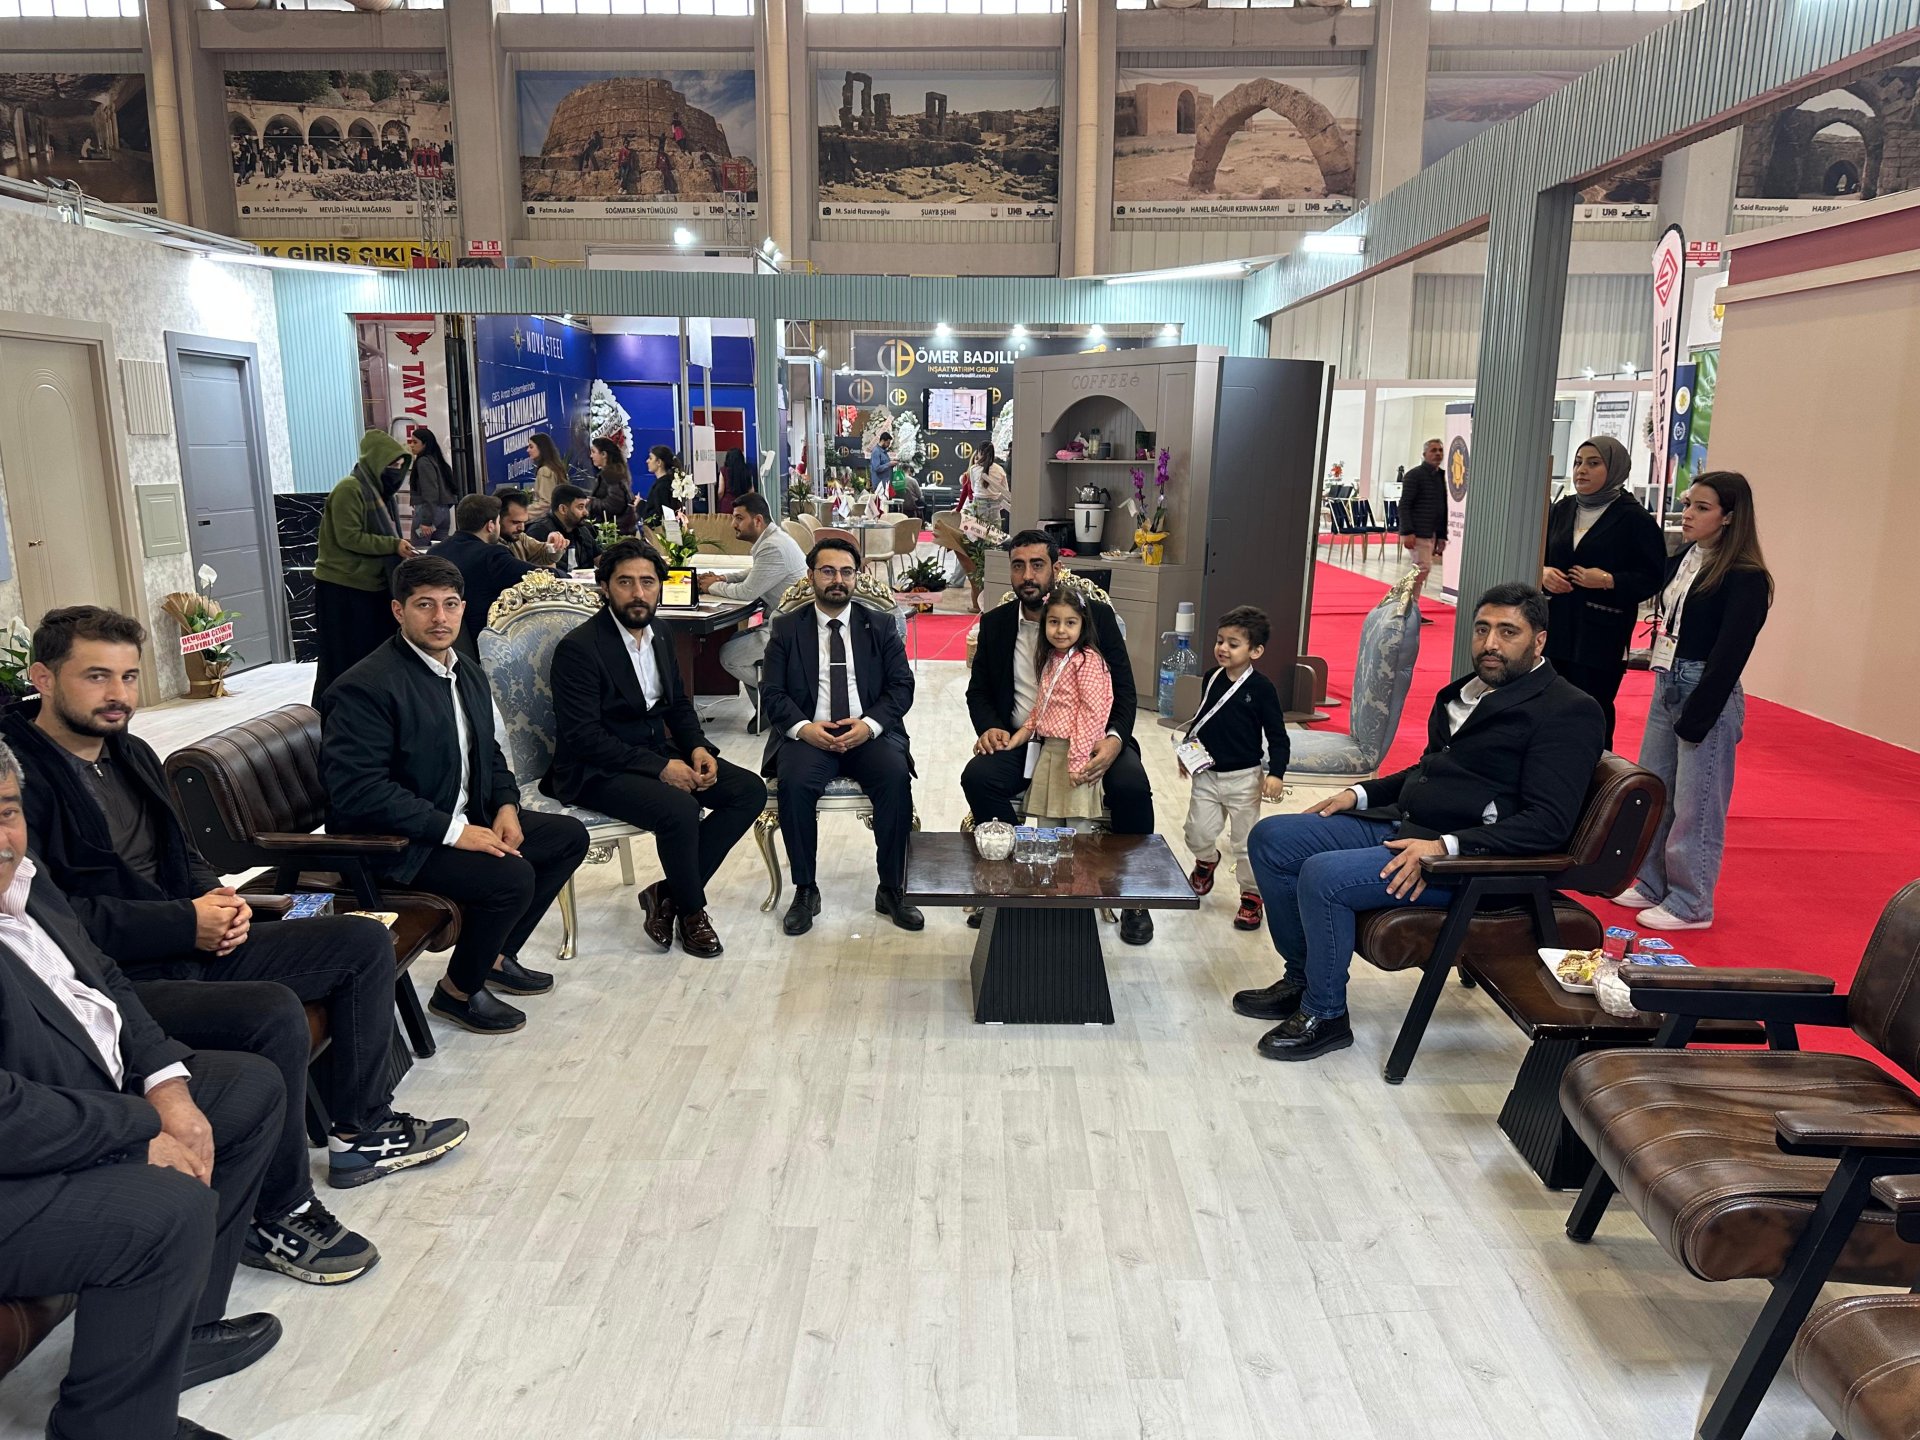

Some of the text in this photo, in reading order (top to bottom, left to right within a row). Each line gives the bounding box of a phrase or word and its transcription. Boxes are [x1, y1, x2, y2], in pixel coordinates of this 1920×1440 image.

[539, 206, 574, 214] Fatma Aslan
[605, 206, 636, 215] SOĞMATAR
[835, 207, 843, 215] M.
[844, 207, 857, 215] Said
[921, 208, 957, 217] ŞUAYB ŞEHRİ
[1211, 205, 1234, 213] BAĞRUR
[1235, 205, 1258, 213] KERVAN
[1259, 205, 1280, 213] SARAYI
[526, 330, 564, 360] NOVA STEEL
[915, 346, 959, 364] ÖMER
[1071, 374, 1128, 390] COFFEE
